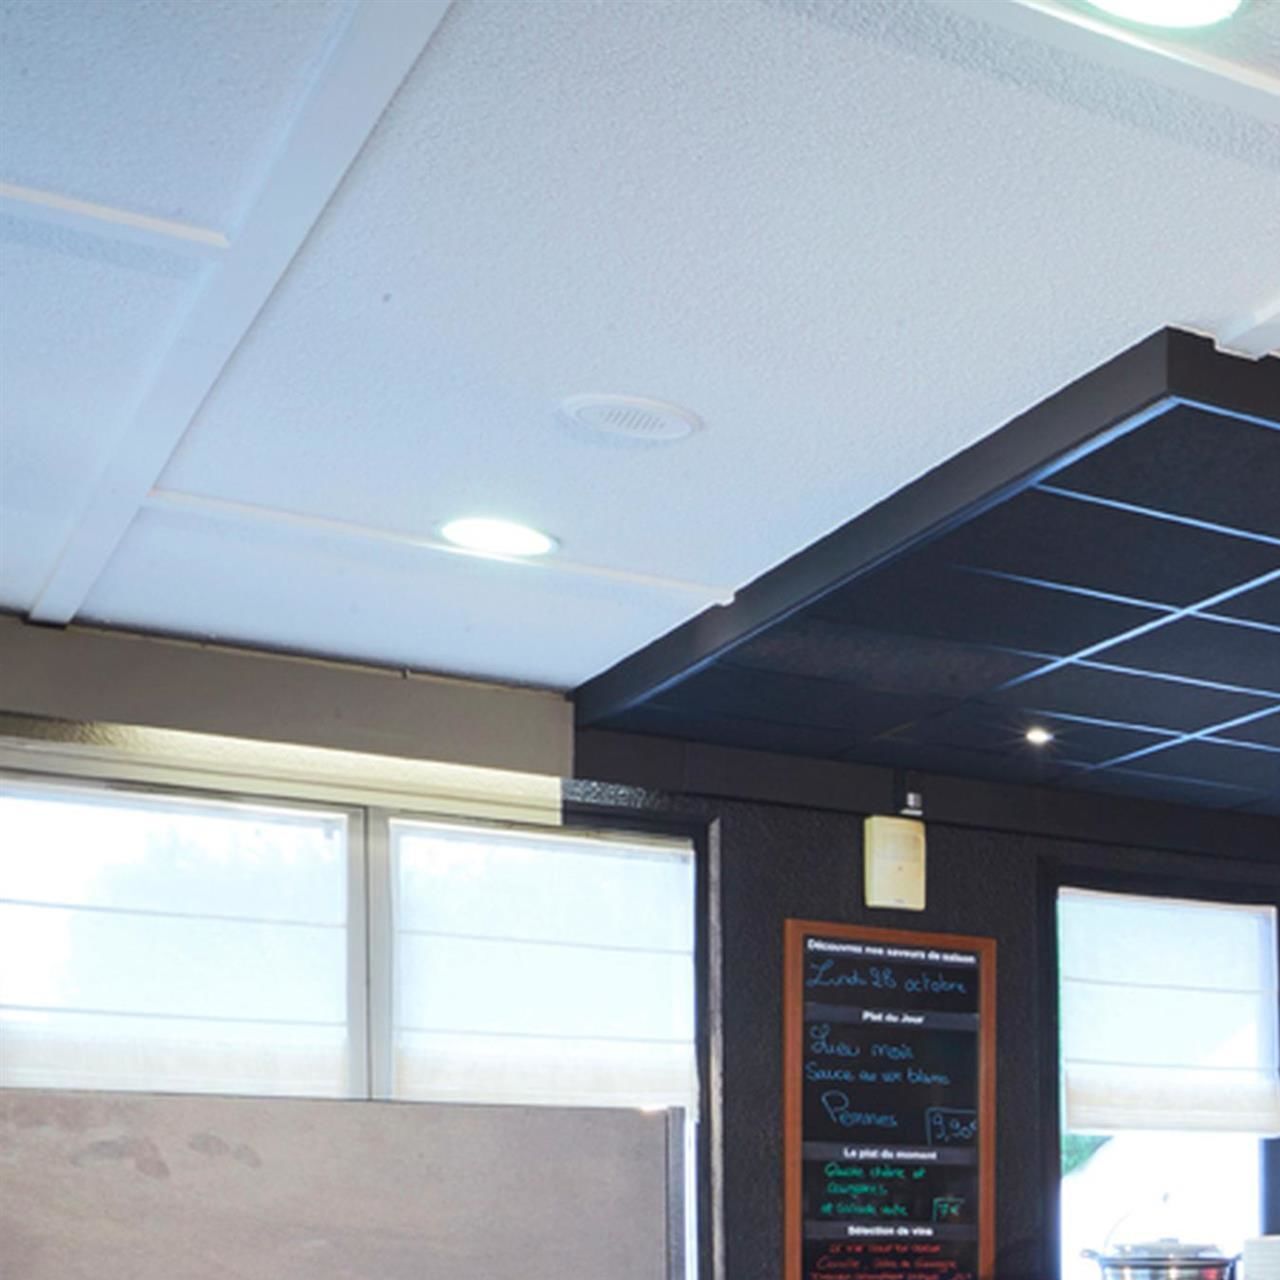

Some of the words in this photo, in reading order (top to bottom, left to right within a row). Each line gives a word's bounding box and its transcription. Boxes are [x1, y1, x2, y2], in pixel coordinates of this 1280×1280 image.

[861, 1010, 883, 1023] Plat
[884, 1012, 900, 1023] du
[901, 1013, 926, 1025] Jour
[842, 1147, 858, 1158] Le
[859, 1148, 879, 1161] plat
[880, 1148, 894, 1160] du
[896, 1224, 910, 1236] de
